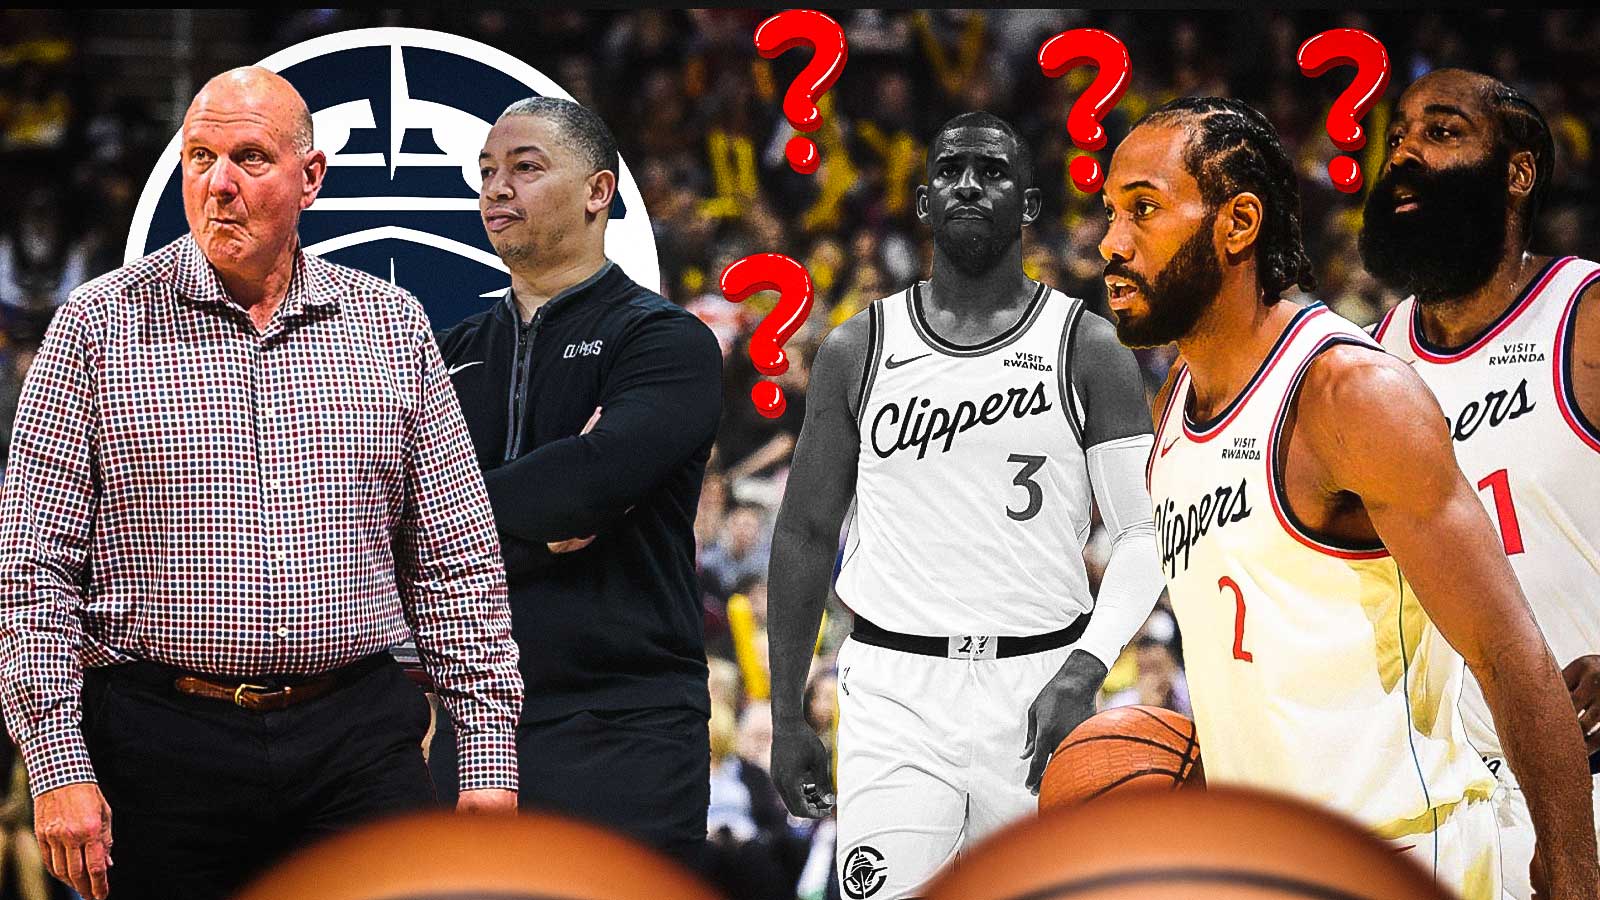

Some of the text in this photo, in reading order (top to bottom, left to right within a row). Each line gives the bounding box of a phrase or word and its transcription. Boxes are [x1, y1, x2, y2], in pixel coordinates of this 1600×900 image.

[1503, 343, 1537, 354] VISIT
[1015, 352, 1044, 363] VISIT
[1489, 352, 1545, 366] RWANDA
[1003, 359, 1053, 372] RWANDA
[1445, 378, 1537, 442] ers
[871, 381, 1053, 460] Clippers
[1233, 437, 1257, 449] VISIT
[1221, 448, 1261, 461] RWANDA
[1006, 453, 1048, 522] 3
[1477, 468, 1526, 556] 1
[1218, 575, 1253, 663] 2
